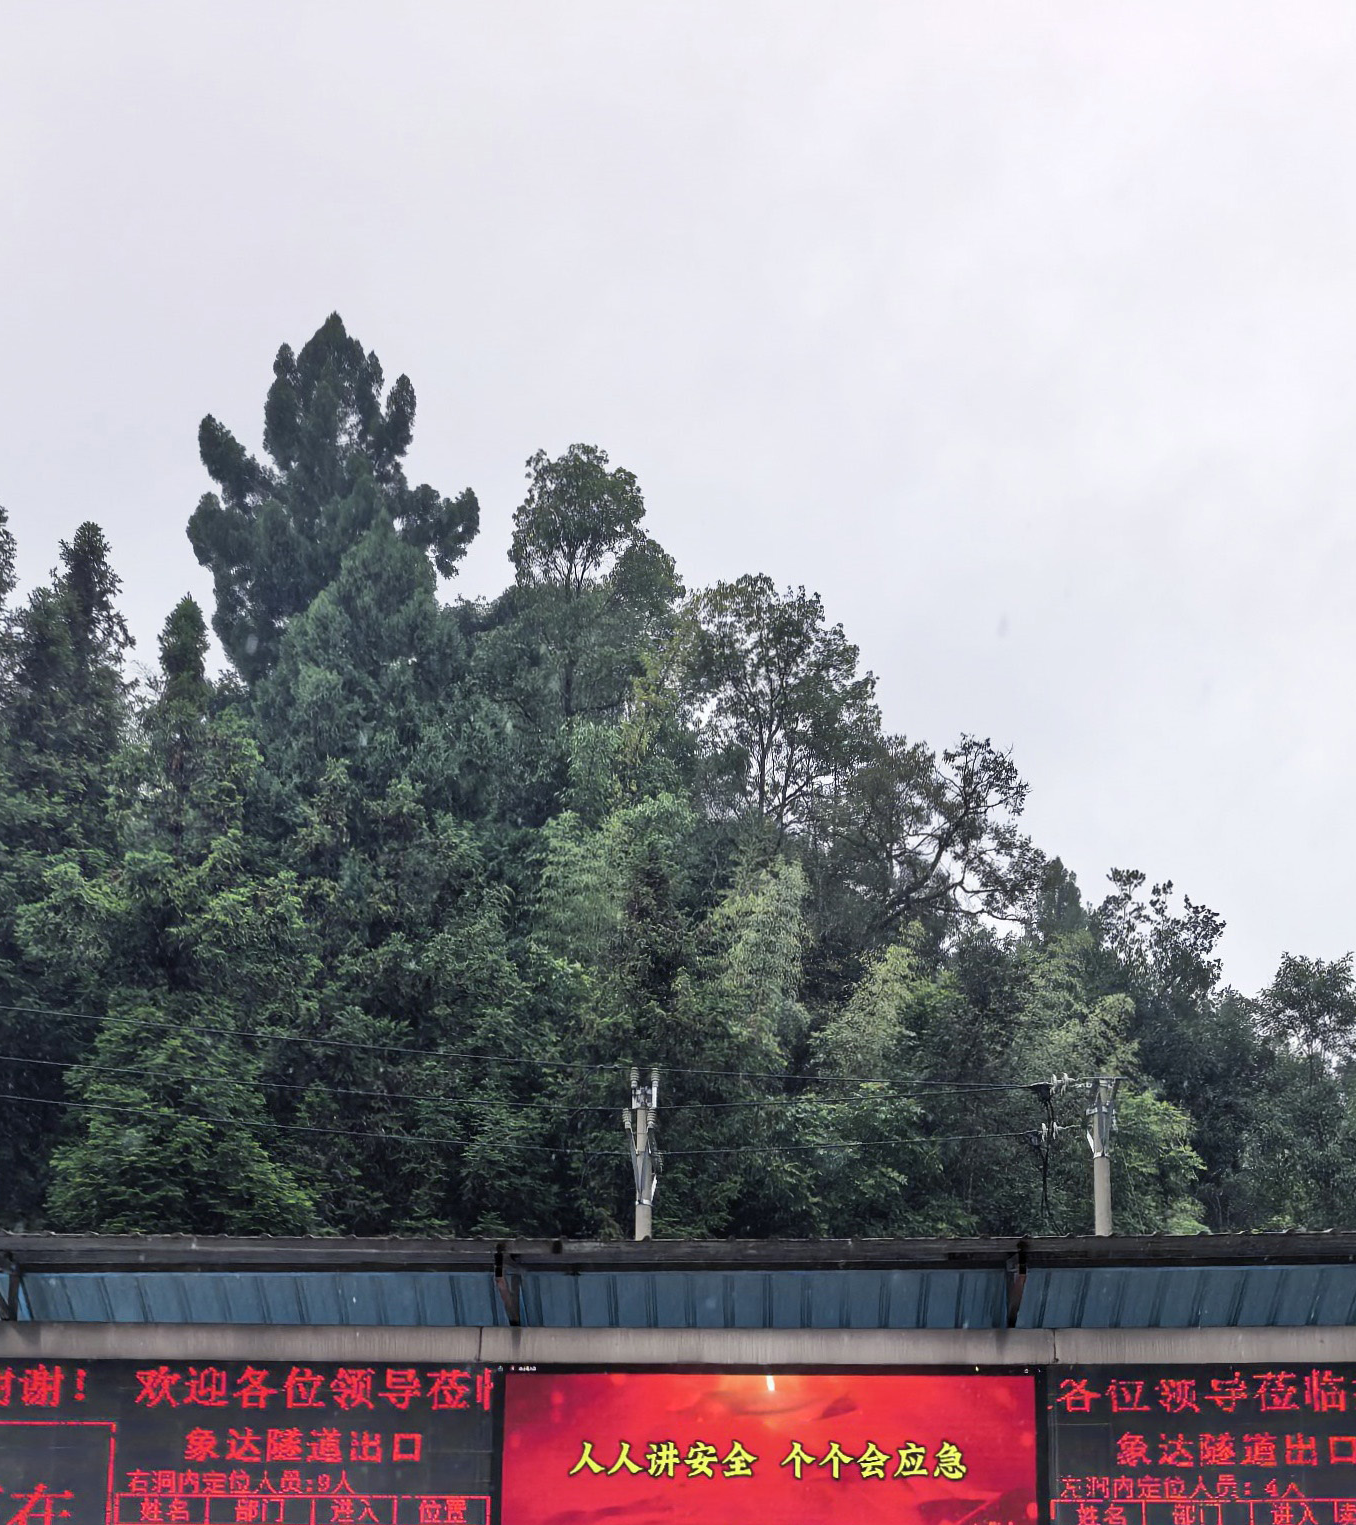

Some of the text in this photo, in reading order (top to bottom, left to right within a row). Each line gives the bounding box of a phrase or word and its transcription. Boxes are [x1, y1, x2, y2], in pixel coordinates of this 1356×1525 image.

[185, 1428, 422, 1463] 象达隧道出口
[569, 1441, 967, 1481] 人人讲安全 个个会应急
[140, 1499, 468, 1523] 姓名 部门 进入 位置
